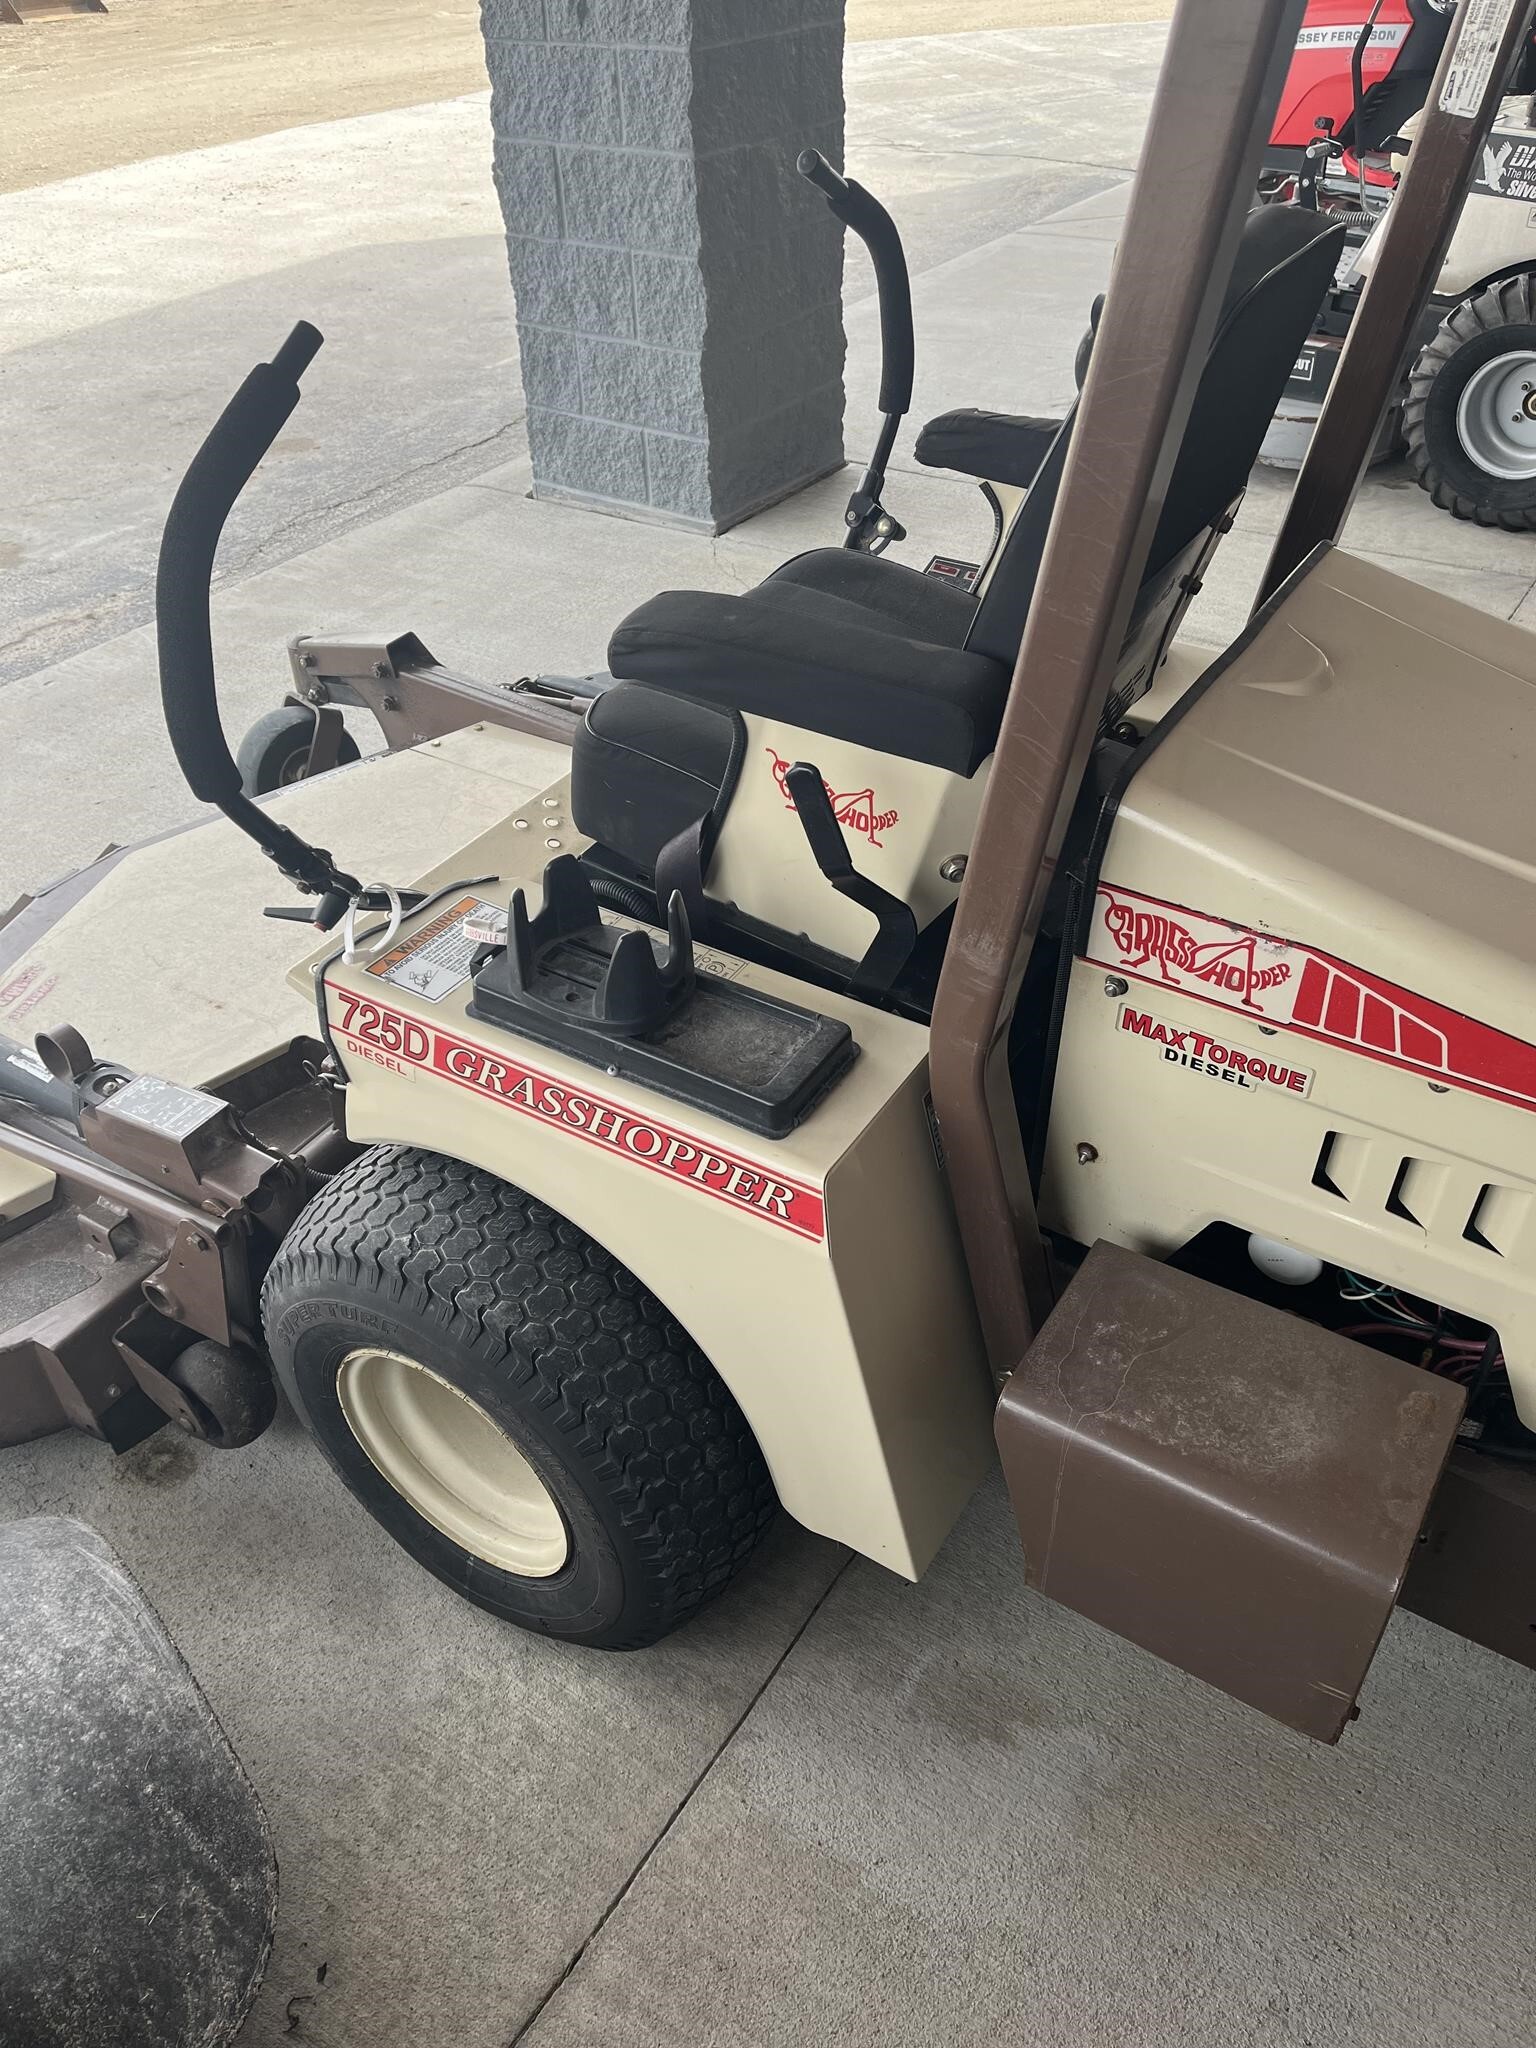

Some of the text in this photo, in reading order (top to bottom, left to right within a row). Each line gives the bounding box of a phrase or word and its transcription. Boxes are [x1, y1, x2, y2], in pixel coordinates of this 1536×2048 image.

[1298, 30, 1396, 43] SSEY FERGSON
[1507, 167, 1522, 179] The
[395, 909, 462, 955] WARNING
[347, 1040, 407, 1076] DIESEL
[1164, 1048, 1250, 1088] DIESEL
[338, 992, 794, 1219] 725D GRASSHOPPER
[277, 1303, 321, 1346] SUPER
